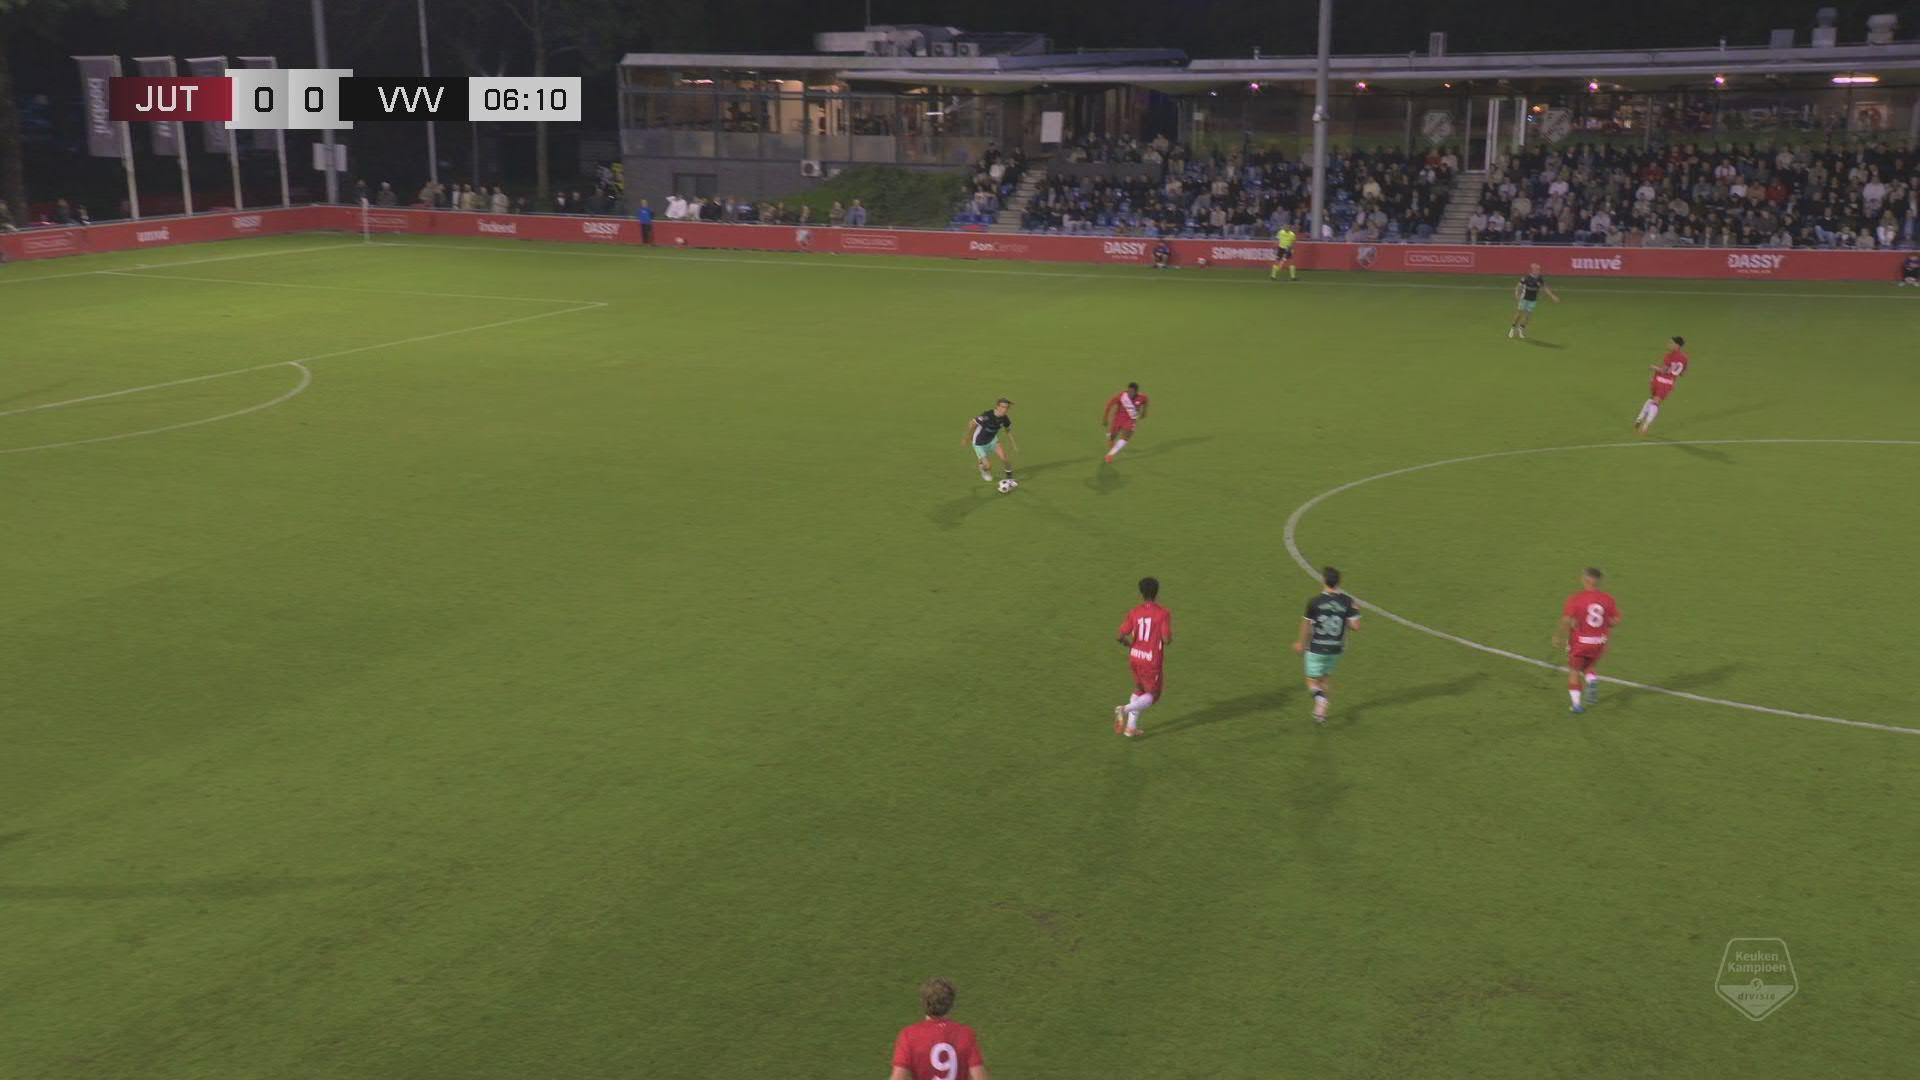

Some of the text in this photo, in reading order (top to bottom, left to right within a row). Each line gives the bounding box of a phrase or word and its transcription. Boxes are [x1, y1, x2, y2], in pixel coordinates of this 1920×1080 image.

[1103, 241, 1147, 256] DASSY
[1408, 253, 1471, 264] CONCLUSION
[1571, 254, 1622, 270] univé
[1727, 254, 1785, 269] DASSY
[1585, 603, 1605, 628] 8
[1137, 616, 1152, 642] 11
[930, 1042, 958, 1080] 9
